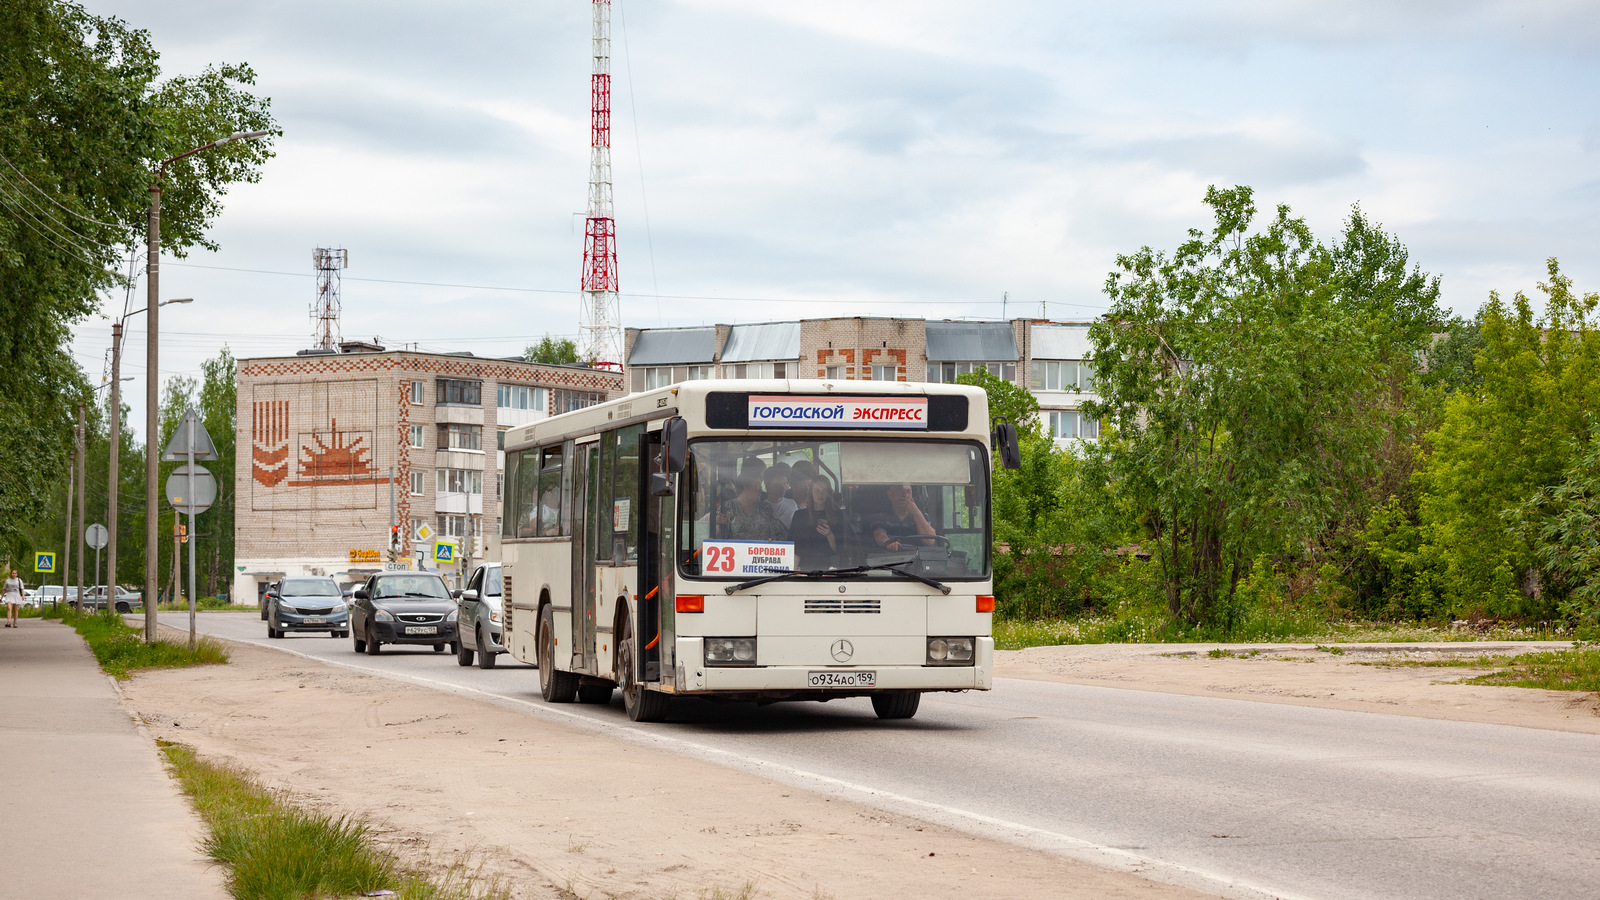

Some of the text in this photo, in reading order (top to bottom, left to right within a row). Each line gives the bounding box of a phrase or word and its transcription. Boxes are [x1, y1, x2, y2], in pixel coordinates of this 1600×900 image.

[753, 405, 922, 420] ГОРОДСКОЙ ЭКСПРЕСС
[748, 547, 786, 556] БОРОВАЯ
[706, 546, 736, 573] 23
[752, 556, 781, 564] ДУБРАВА
[811, 673, 873, 685] О934АО 159
